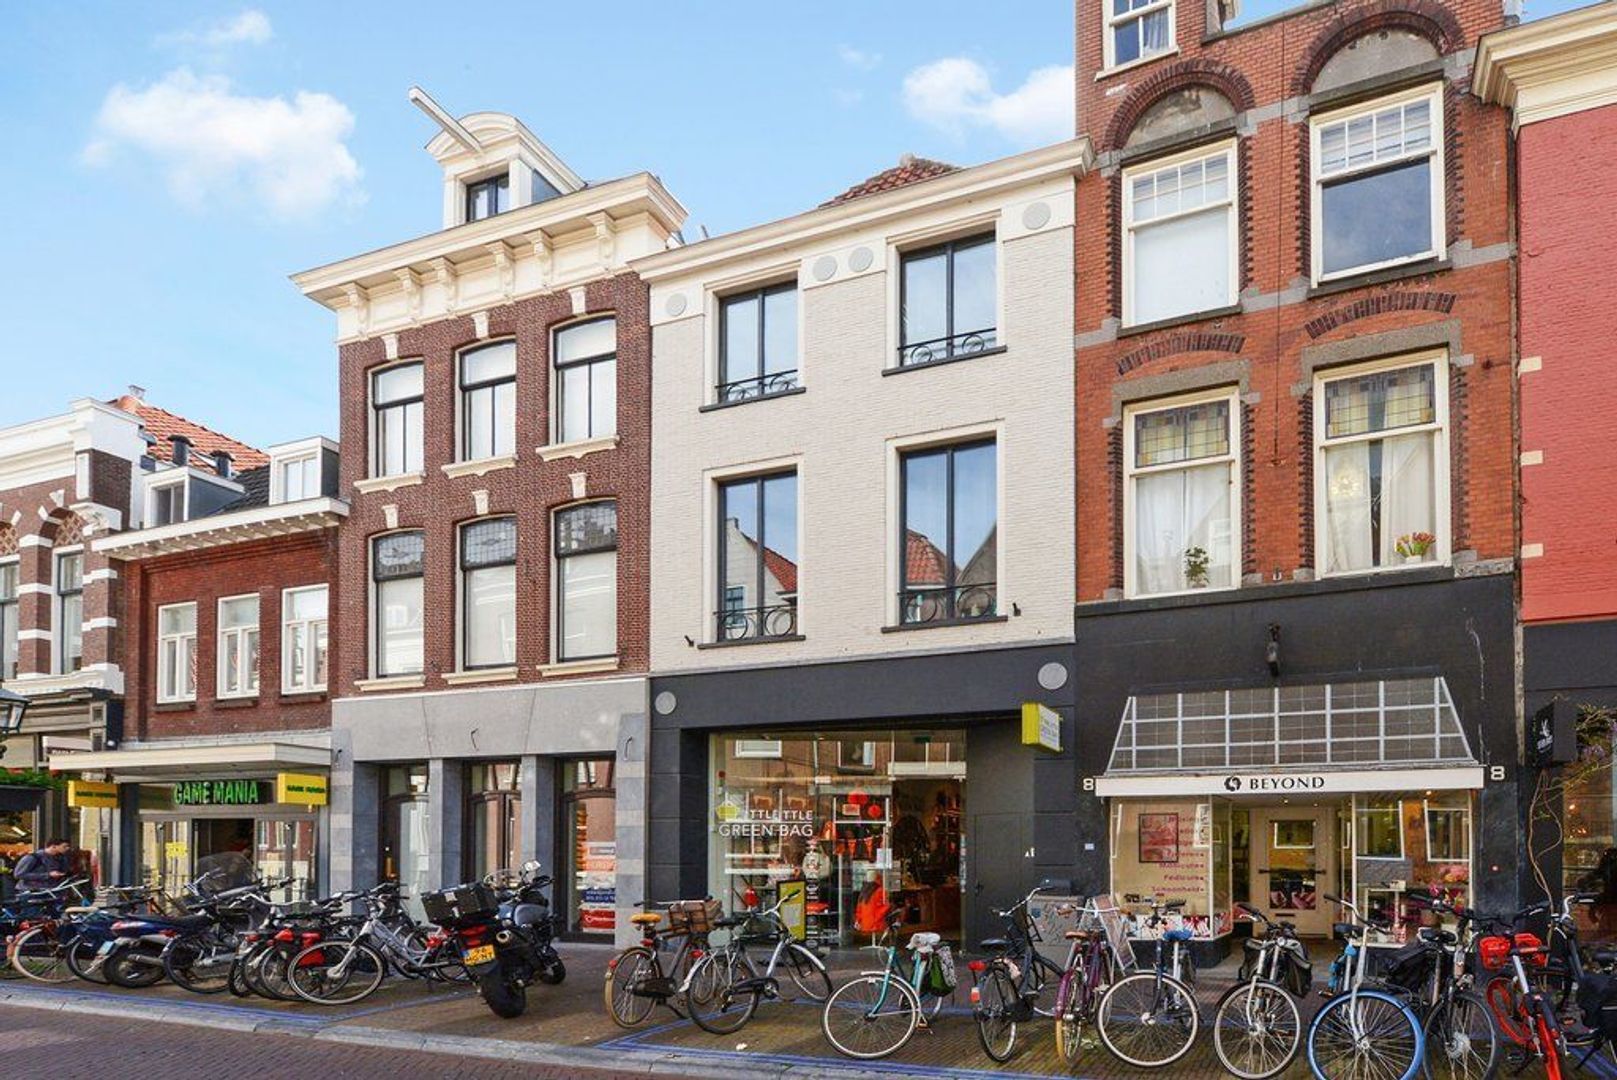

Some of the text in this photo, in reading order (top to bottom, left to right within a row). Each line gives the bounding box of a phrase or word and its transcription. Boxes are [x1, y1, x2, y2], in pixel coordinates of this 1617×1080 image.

[1490, 766, 1505, 781] 8
[1083, 778, 1094, 791] 8
[1250, 776, 1325, 790] BEYOND
[174, 781, 258, 804] GAME MANIA
[718, 824, 813, 837] GREEN BAG
